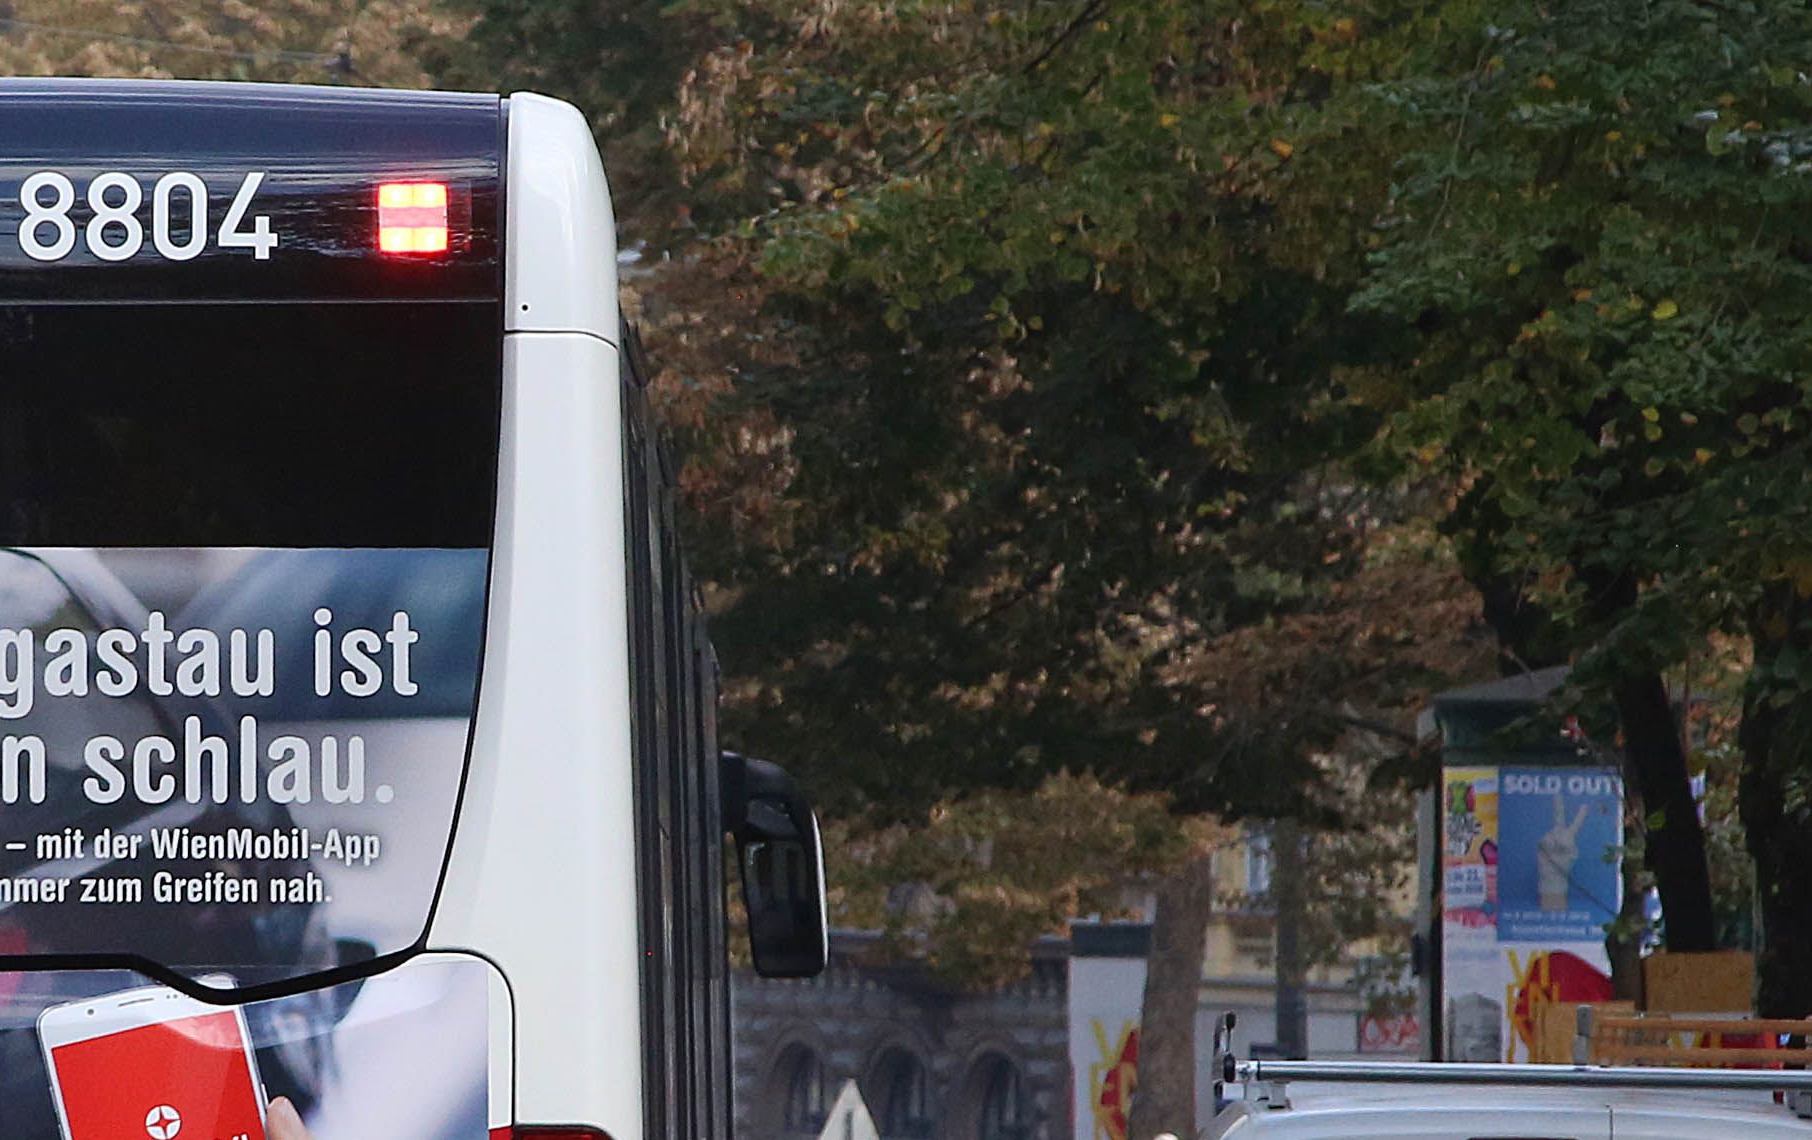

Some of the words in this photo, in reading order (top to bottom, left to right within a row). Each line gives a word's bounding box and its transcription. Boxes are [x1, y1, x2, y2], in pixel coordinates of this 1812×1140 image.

[17, 171, 280, 262] 8804
[314, 607, 419, 697] ist
[83, 714, 395, 805] schlau.
[1504, 775, 1562, 794] SOLD
[37, 827, 85, 860] mit
[94, 828, 143, 860] der
[150, 827, 382, 867] WienMobil-App
[79, 876, 143, 902] zum
[152, 870, 259, 903] Greifen
[269, 871, 333, 902] nah.
